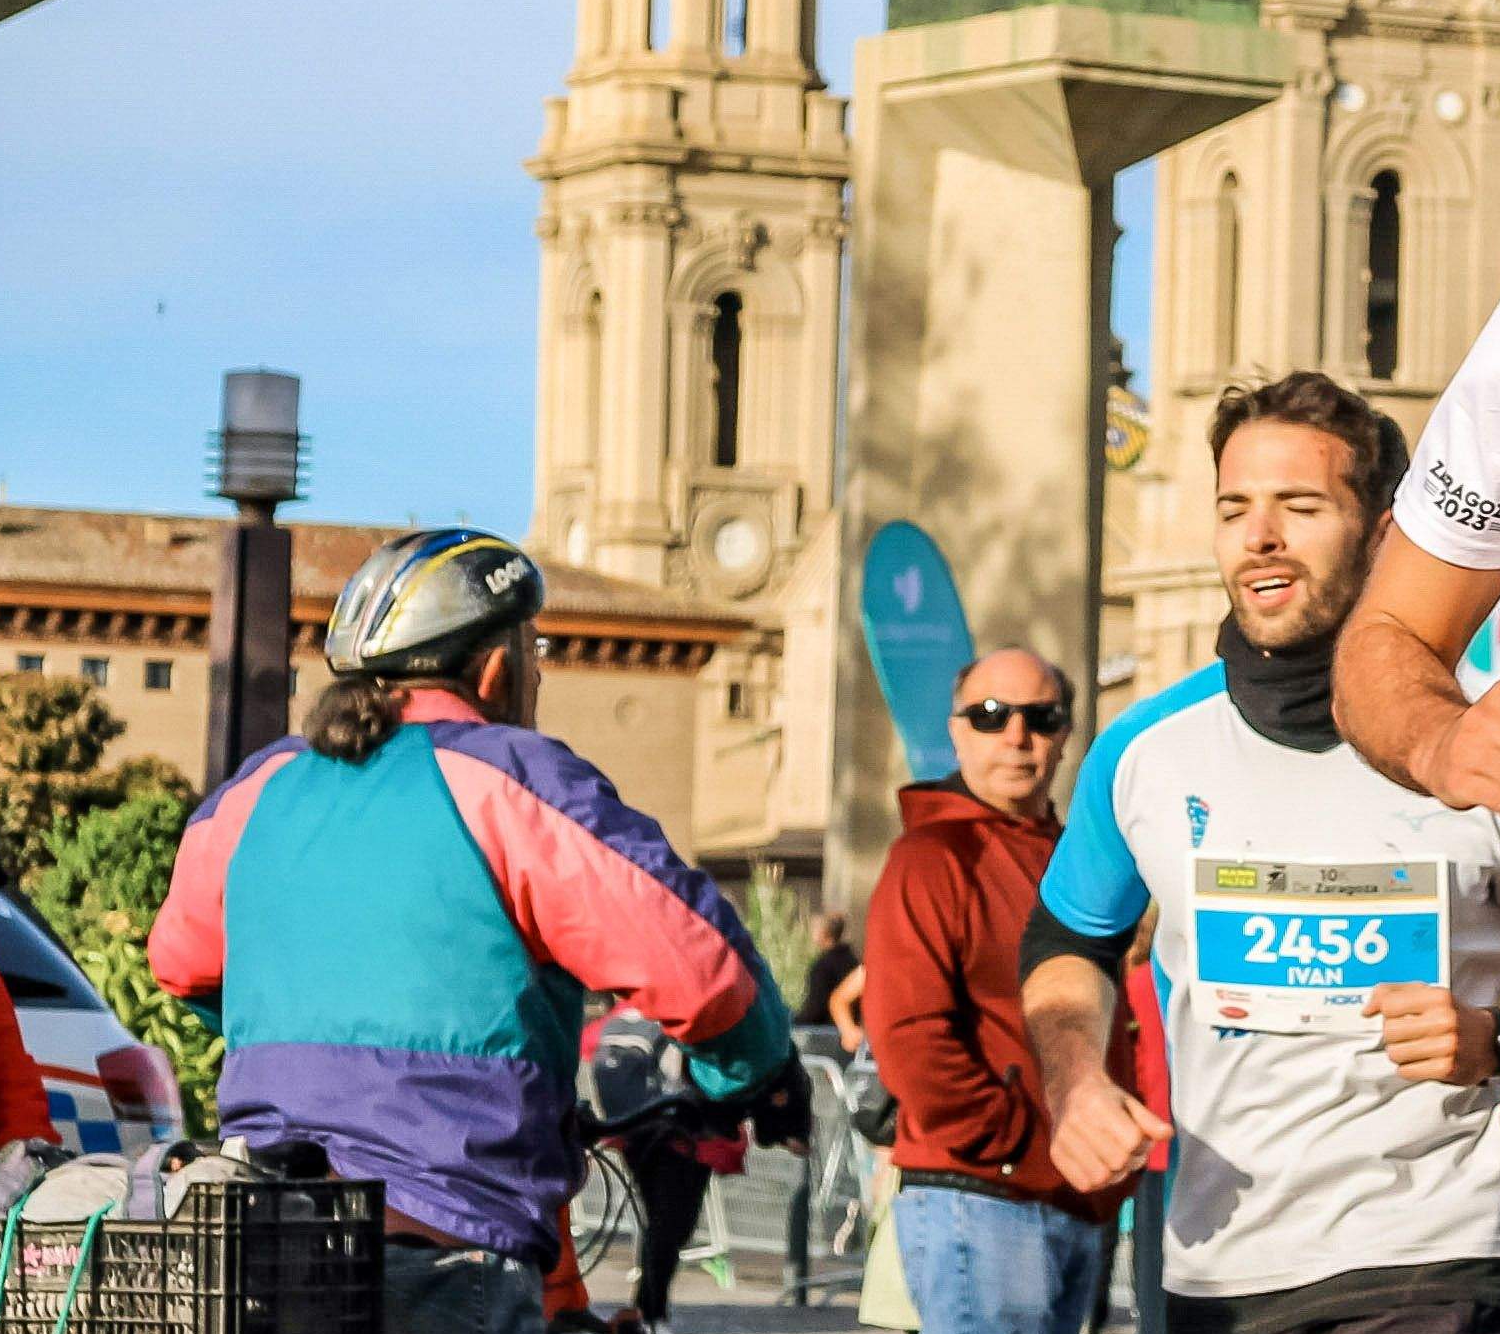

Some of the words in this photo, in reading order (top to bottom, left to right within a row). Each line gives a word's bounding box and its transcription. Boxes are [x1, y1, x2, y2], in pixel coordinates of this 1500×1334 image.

[1434, 490, 1489, 531] 2023
[1242, 914, 1390, 966] 2456
[1287, 968, 1345, 986] IVAN
